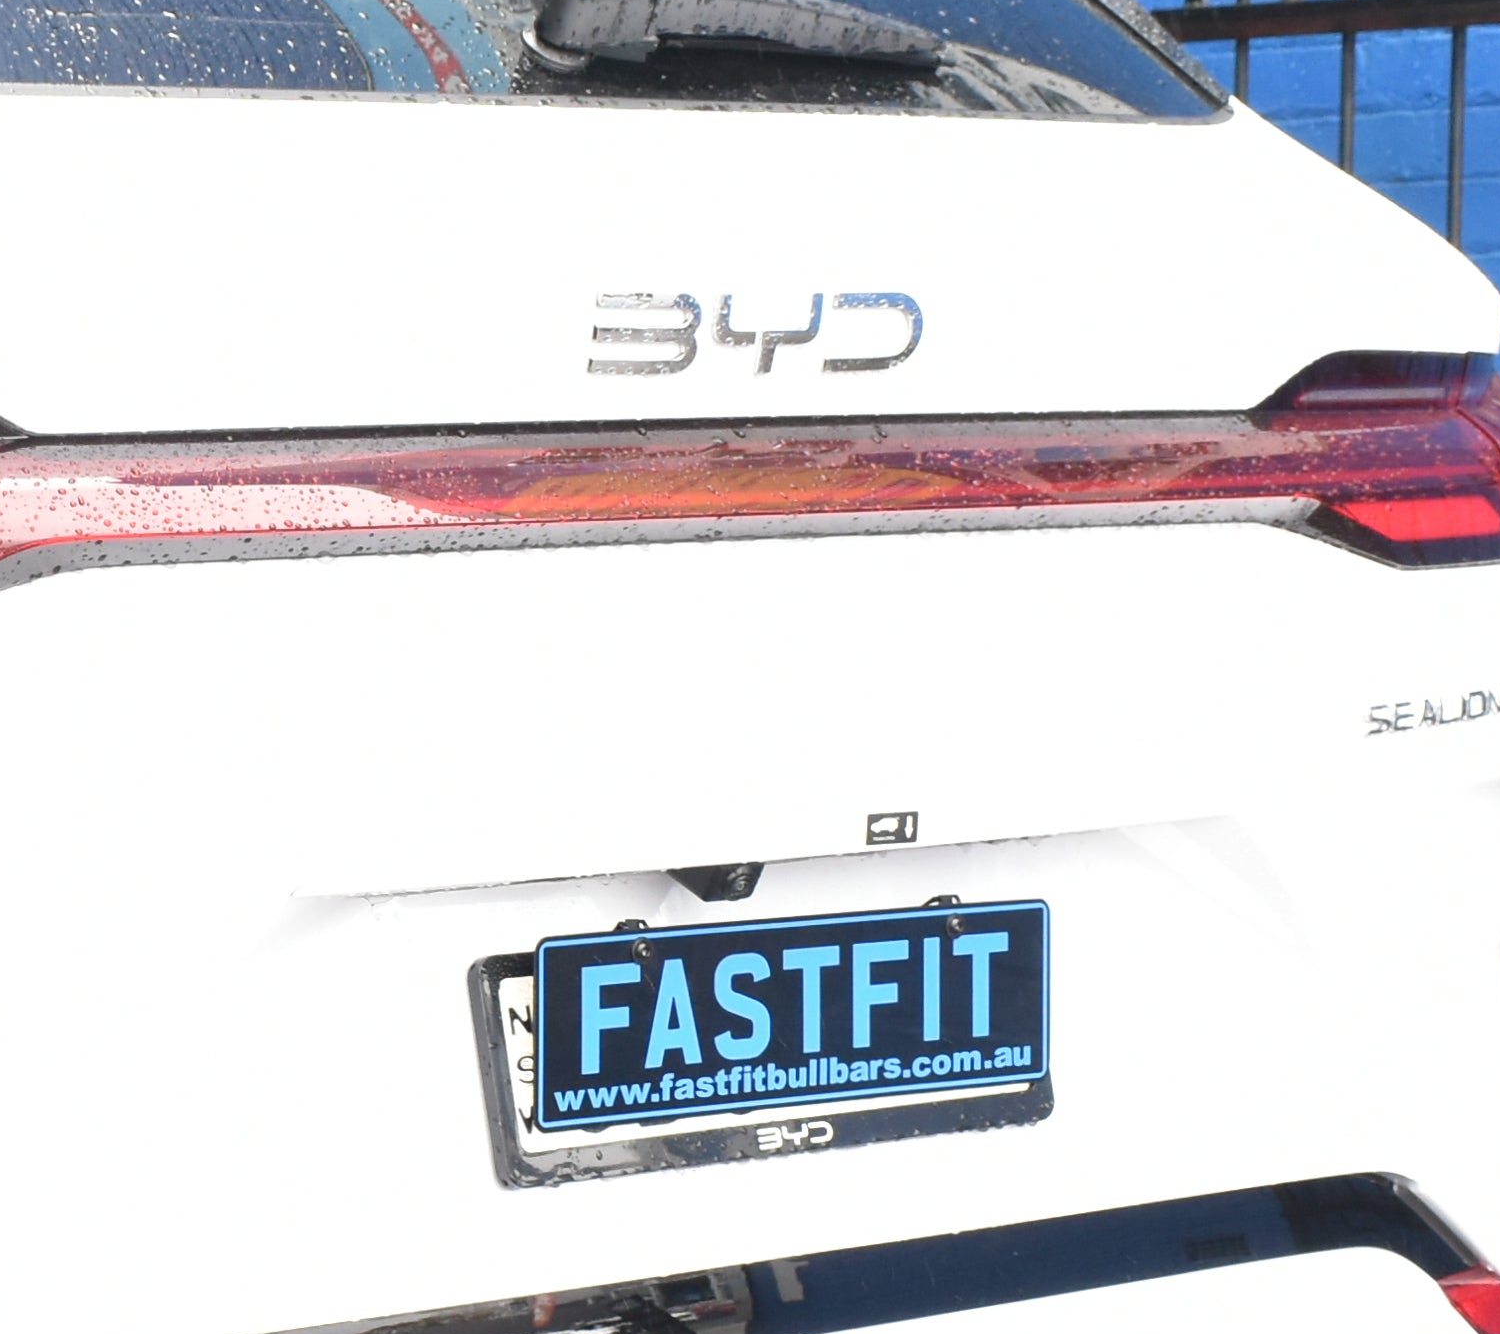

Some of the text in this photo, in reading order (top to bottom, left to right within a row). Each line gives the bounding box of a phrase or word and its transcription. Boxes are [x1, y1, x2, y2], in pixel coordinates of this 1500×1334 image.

[586, 291, 923, 376] BYD
[580, 931, 1010, 1076] FASTFIT
[553, 1043, 1033, 1113] www.fastfitbullbars.com.au
[756, 1120, 834, 1150] BYD
